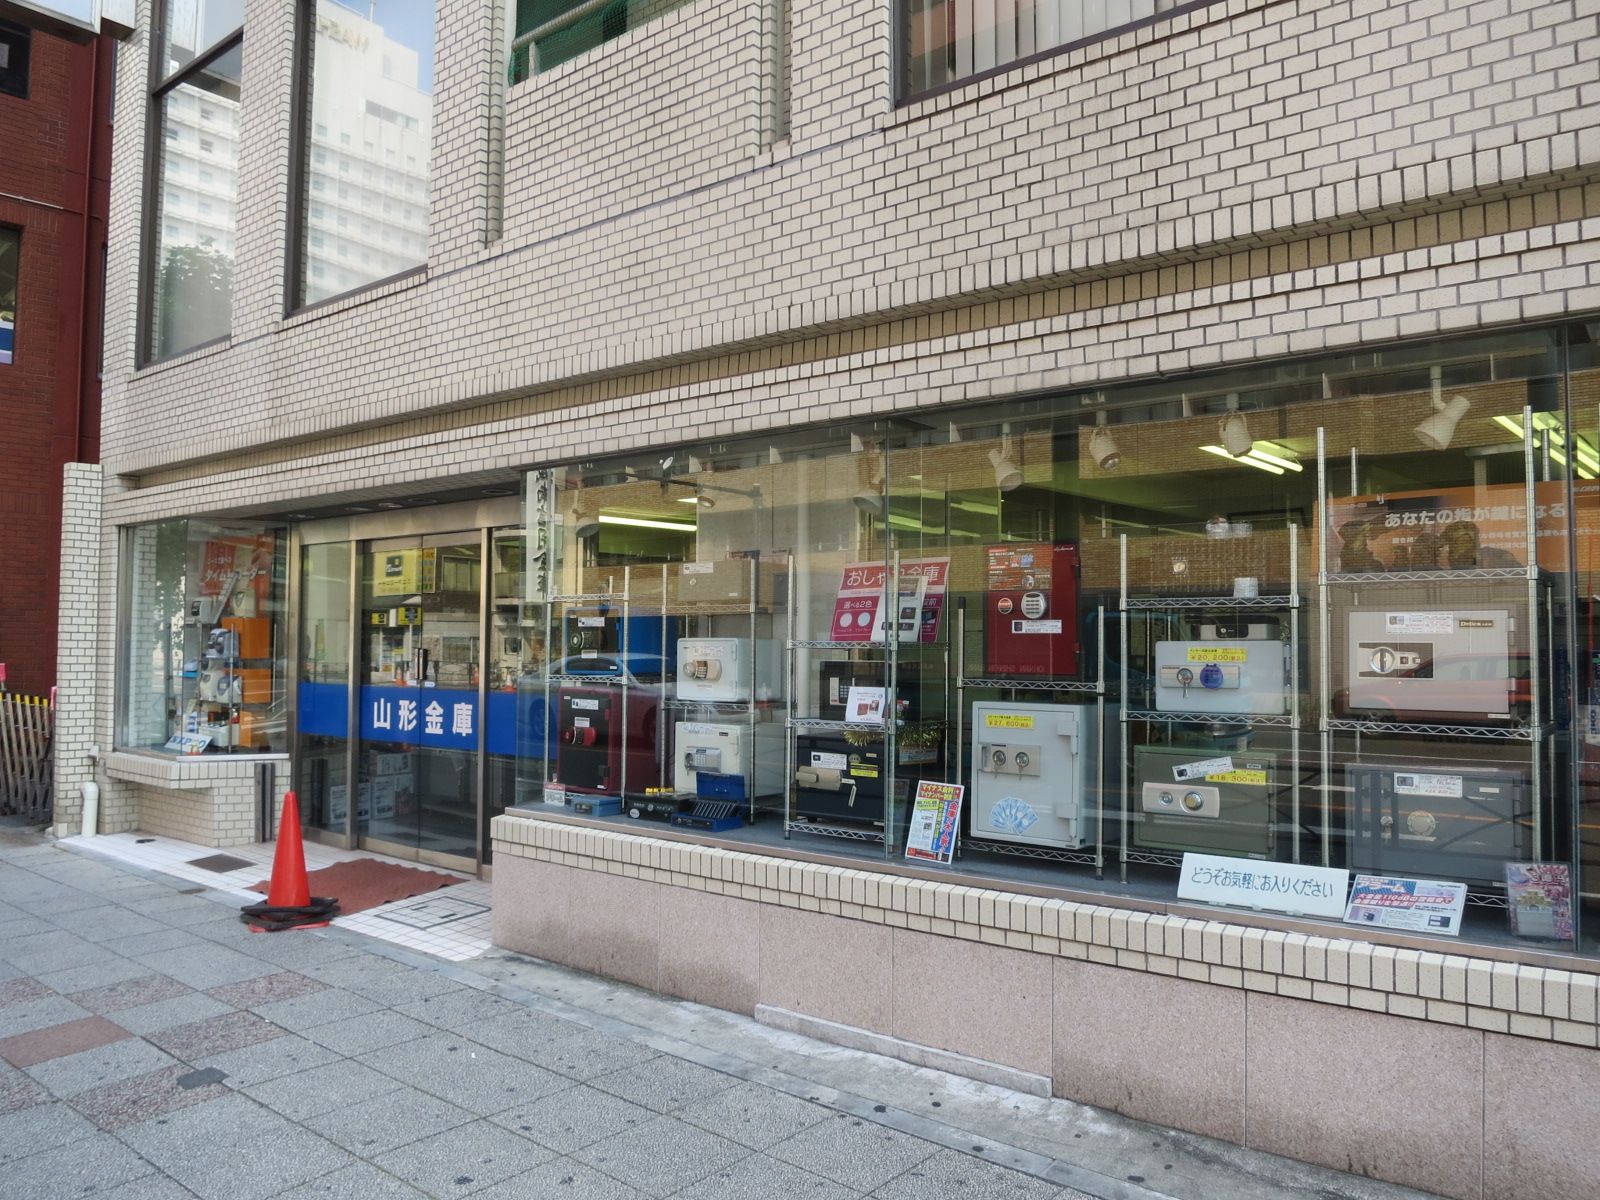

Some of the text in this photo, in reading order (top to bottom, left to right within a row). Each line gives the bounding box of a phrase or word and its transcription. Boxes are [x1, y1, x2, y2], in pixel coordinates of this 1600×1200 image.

[847, 566, 940, 586] おしゃ金庫
[374, 698, 473, 737] 山形金庫
[1191, 866, 1334, 898] どうぞお気軽にお入りください
